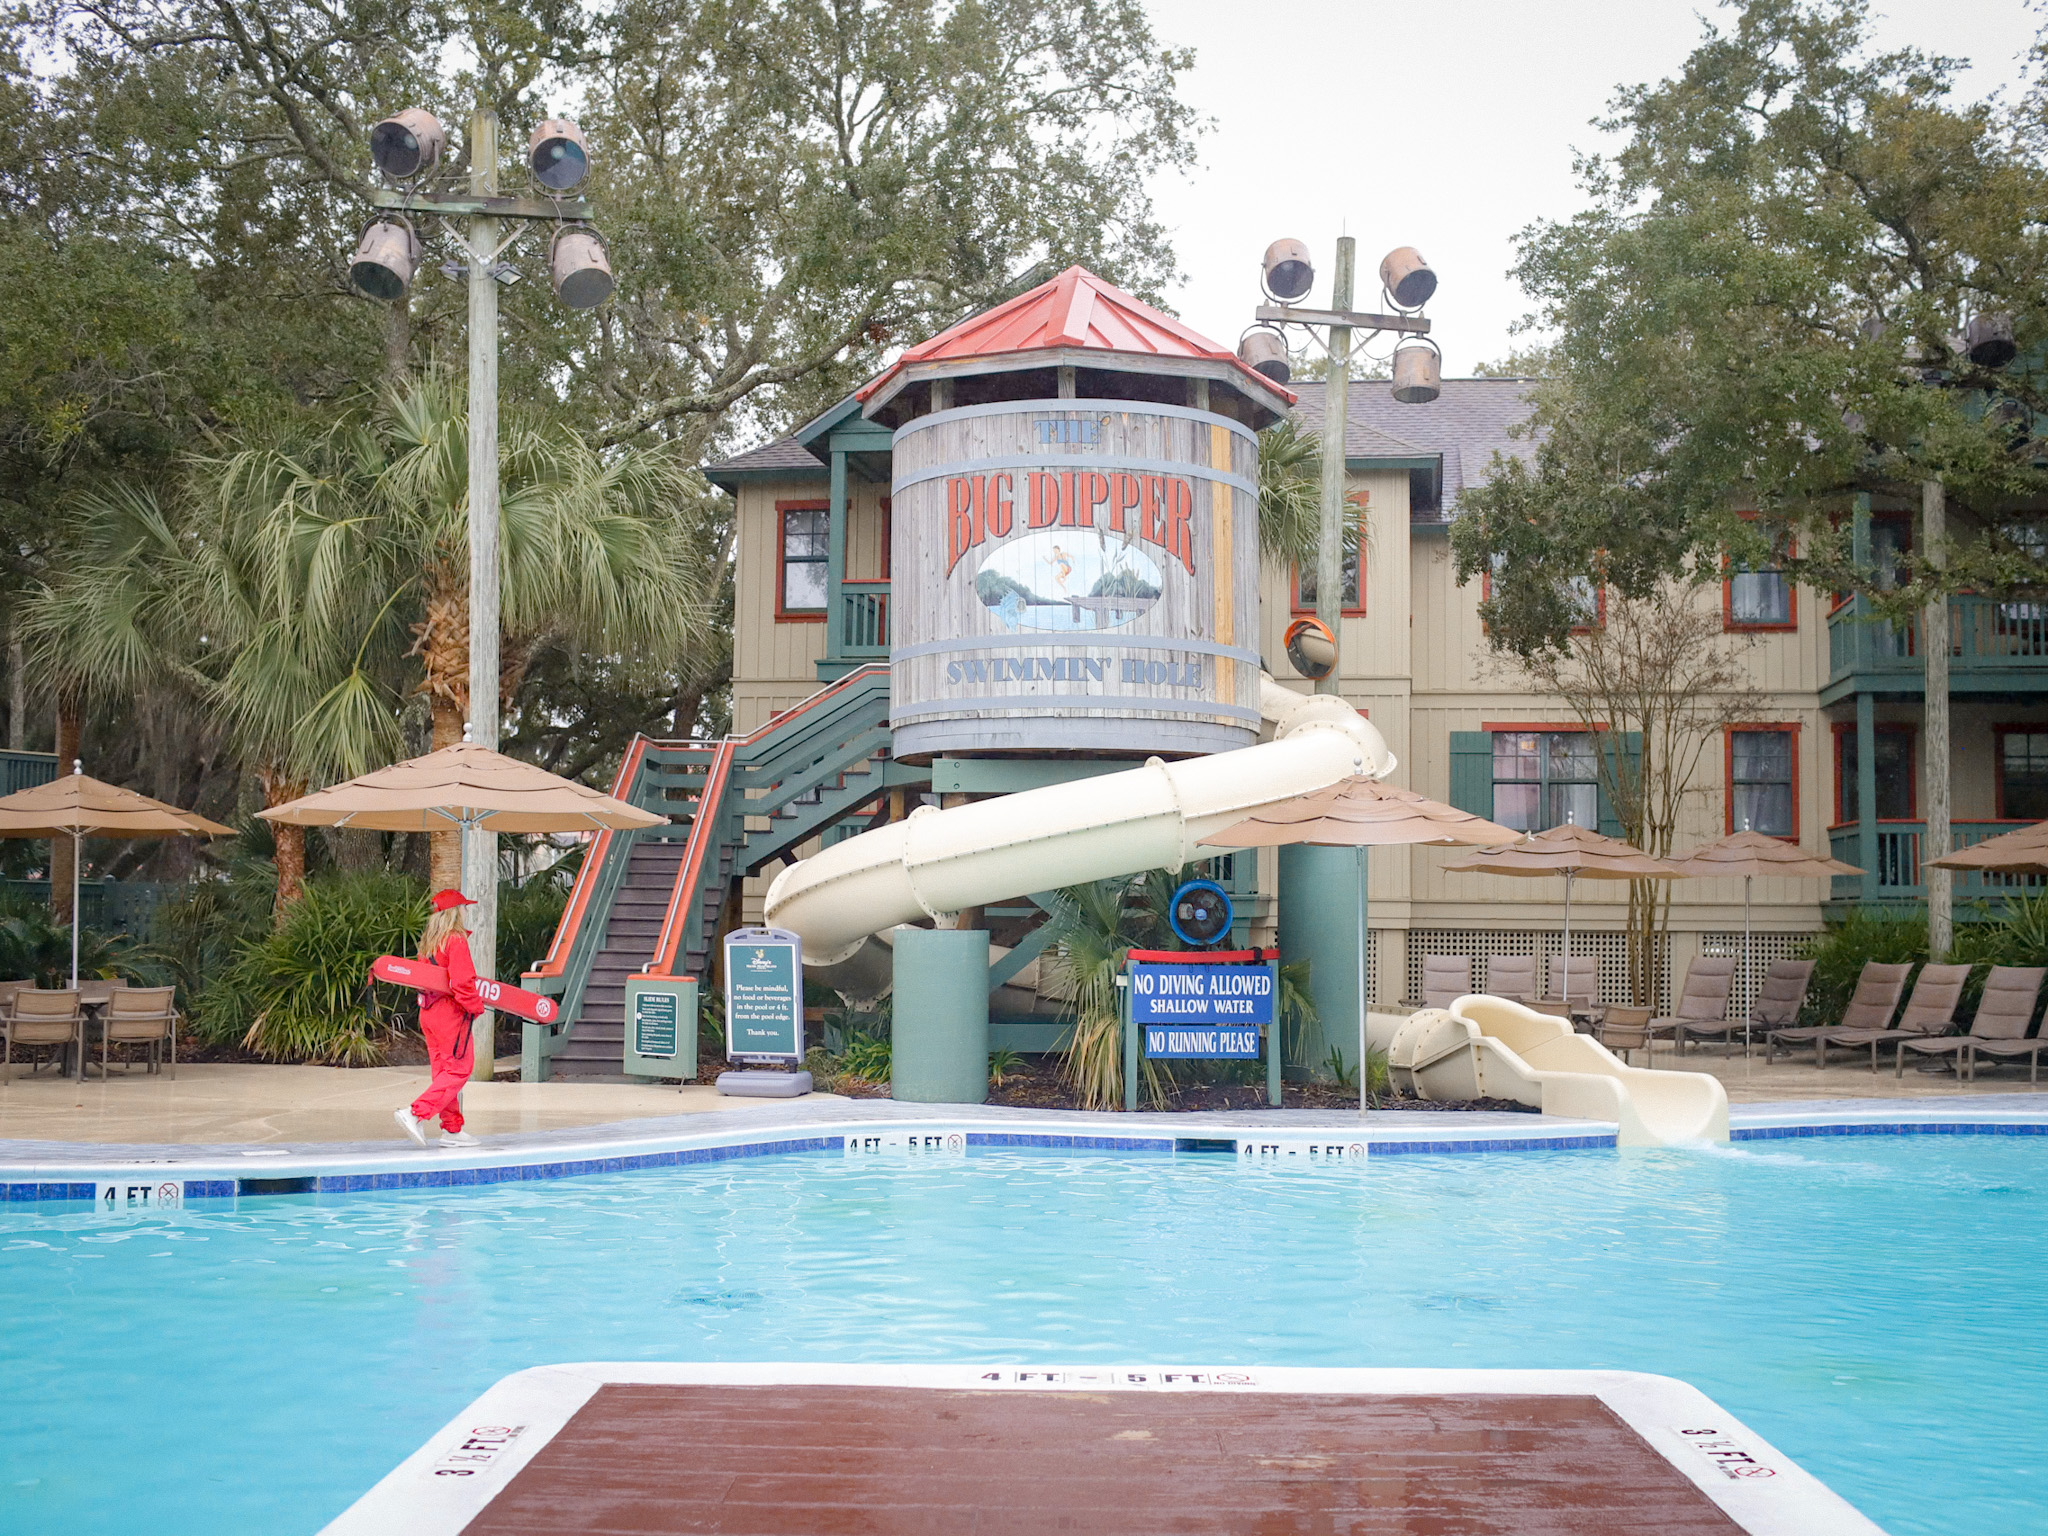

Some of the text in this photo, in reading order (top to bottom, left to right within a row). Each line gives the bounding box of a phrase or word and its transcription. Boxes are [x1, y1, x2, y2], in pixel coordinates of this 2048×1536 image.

[1034, 420, 1100, 444] THE
[946, 472, 1195, 579] BIG DIPPER
[946, 657, 1201, 689] SWIMMIN' HOLE
[1134, 974, 1271, 996] NO DIVING ALLOWED
[764, 994, 792, 1002] beverages
[1150, 999, 1254, 1014] SHALLOW WATER
[761, 1013, 775, 1021] pool
[746, 1028, 766, 1036] Thank
[1149, 1032, 1255, 1053] NO RUNNING PLEASE
[850, 1138, 858, 1148] 4
[864, 1138, 881, 1148] FT
[908, 1136, 917, 1147] 5
[924, 1136, 942, 1147] FT
[1244, 1144, 1253, 1154] 4
[1261, 1145, 1279, 1154] FT
[1326, 1145, 1344, 1155] FT
[104, 1186, 151, 1199] 4 FT
[981, 1372, 1000, 1381] 4
[1127, 1374, 1147, 1382] 5
